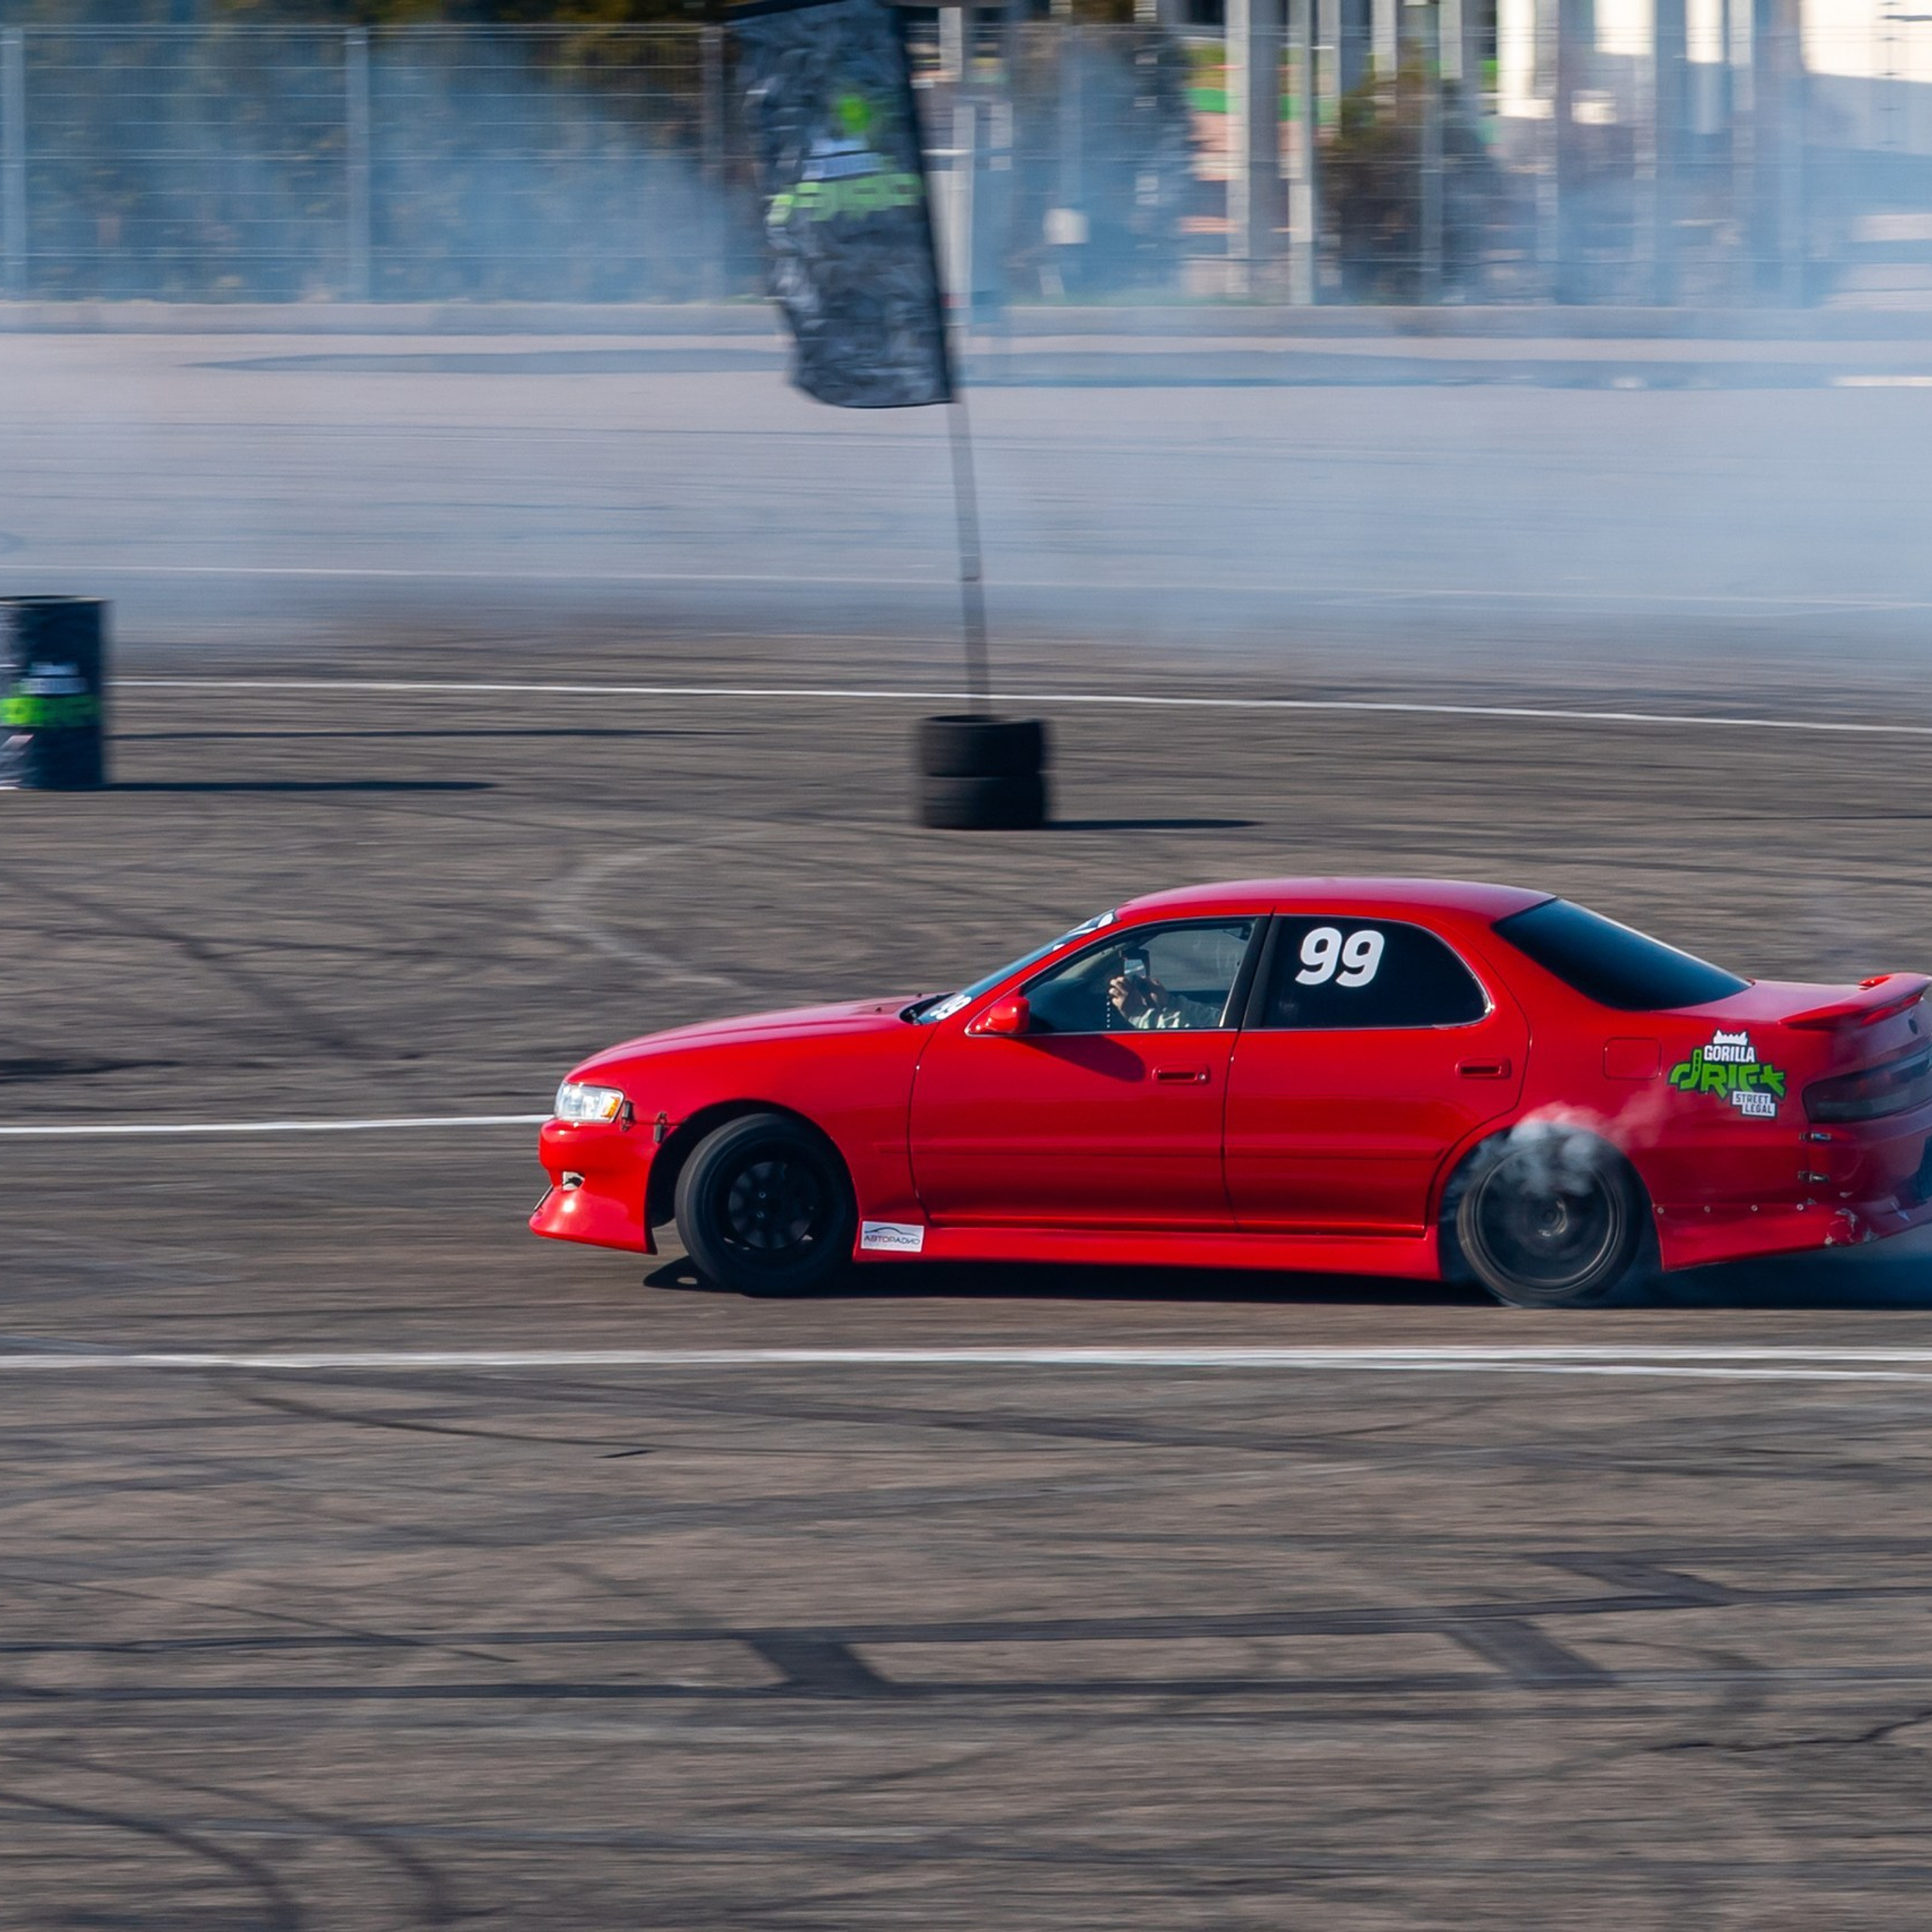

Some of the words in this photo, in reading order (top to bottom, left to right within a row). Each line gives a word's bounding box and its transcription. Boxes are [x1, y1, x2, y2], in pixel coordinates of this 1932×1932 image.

[1294, 927, 1386, 988] 99
[1703, 1044, 1756, 1063] GORILLA
[1735, 1094, 1770, 1104] STREET
[1744, 1104, 1773, 1114] LEGAL
